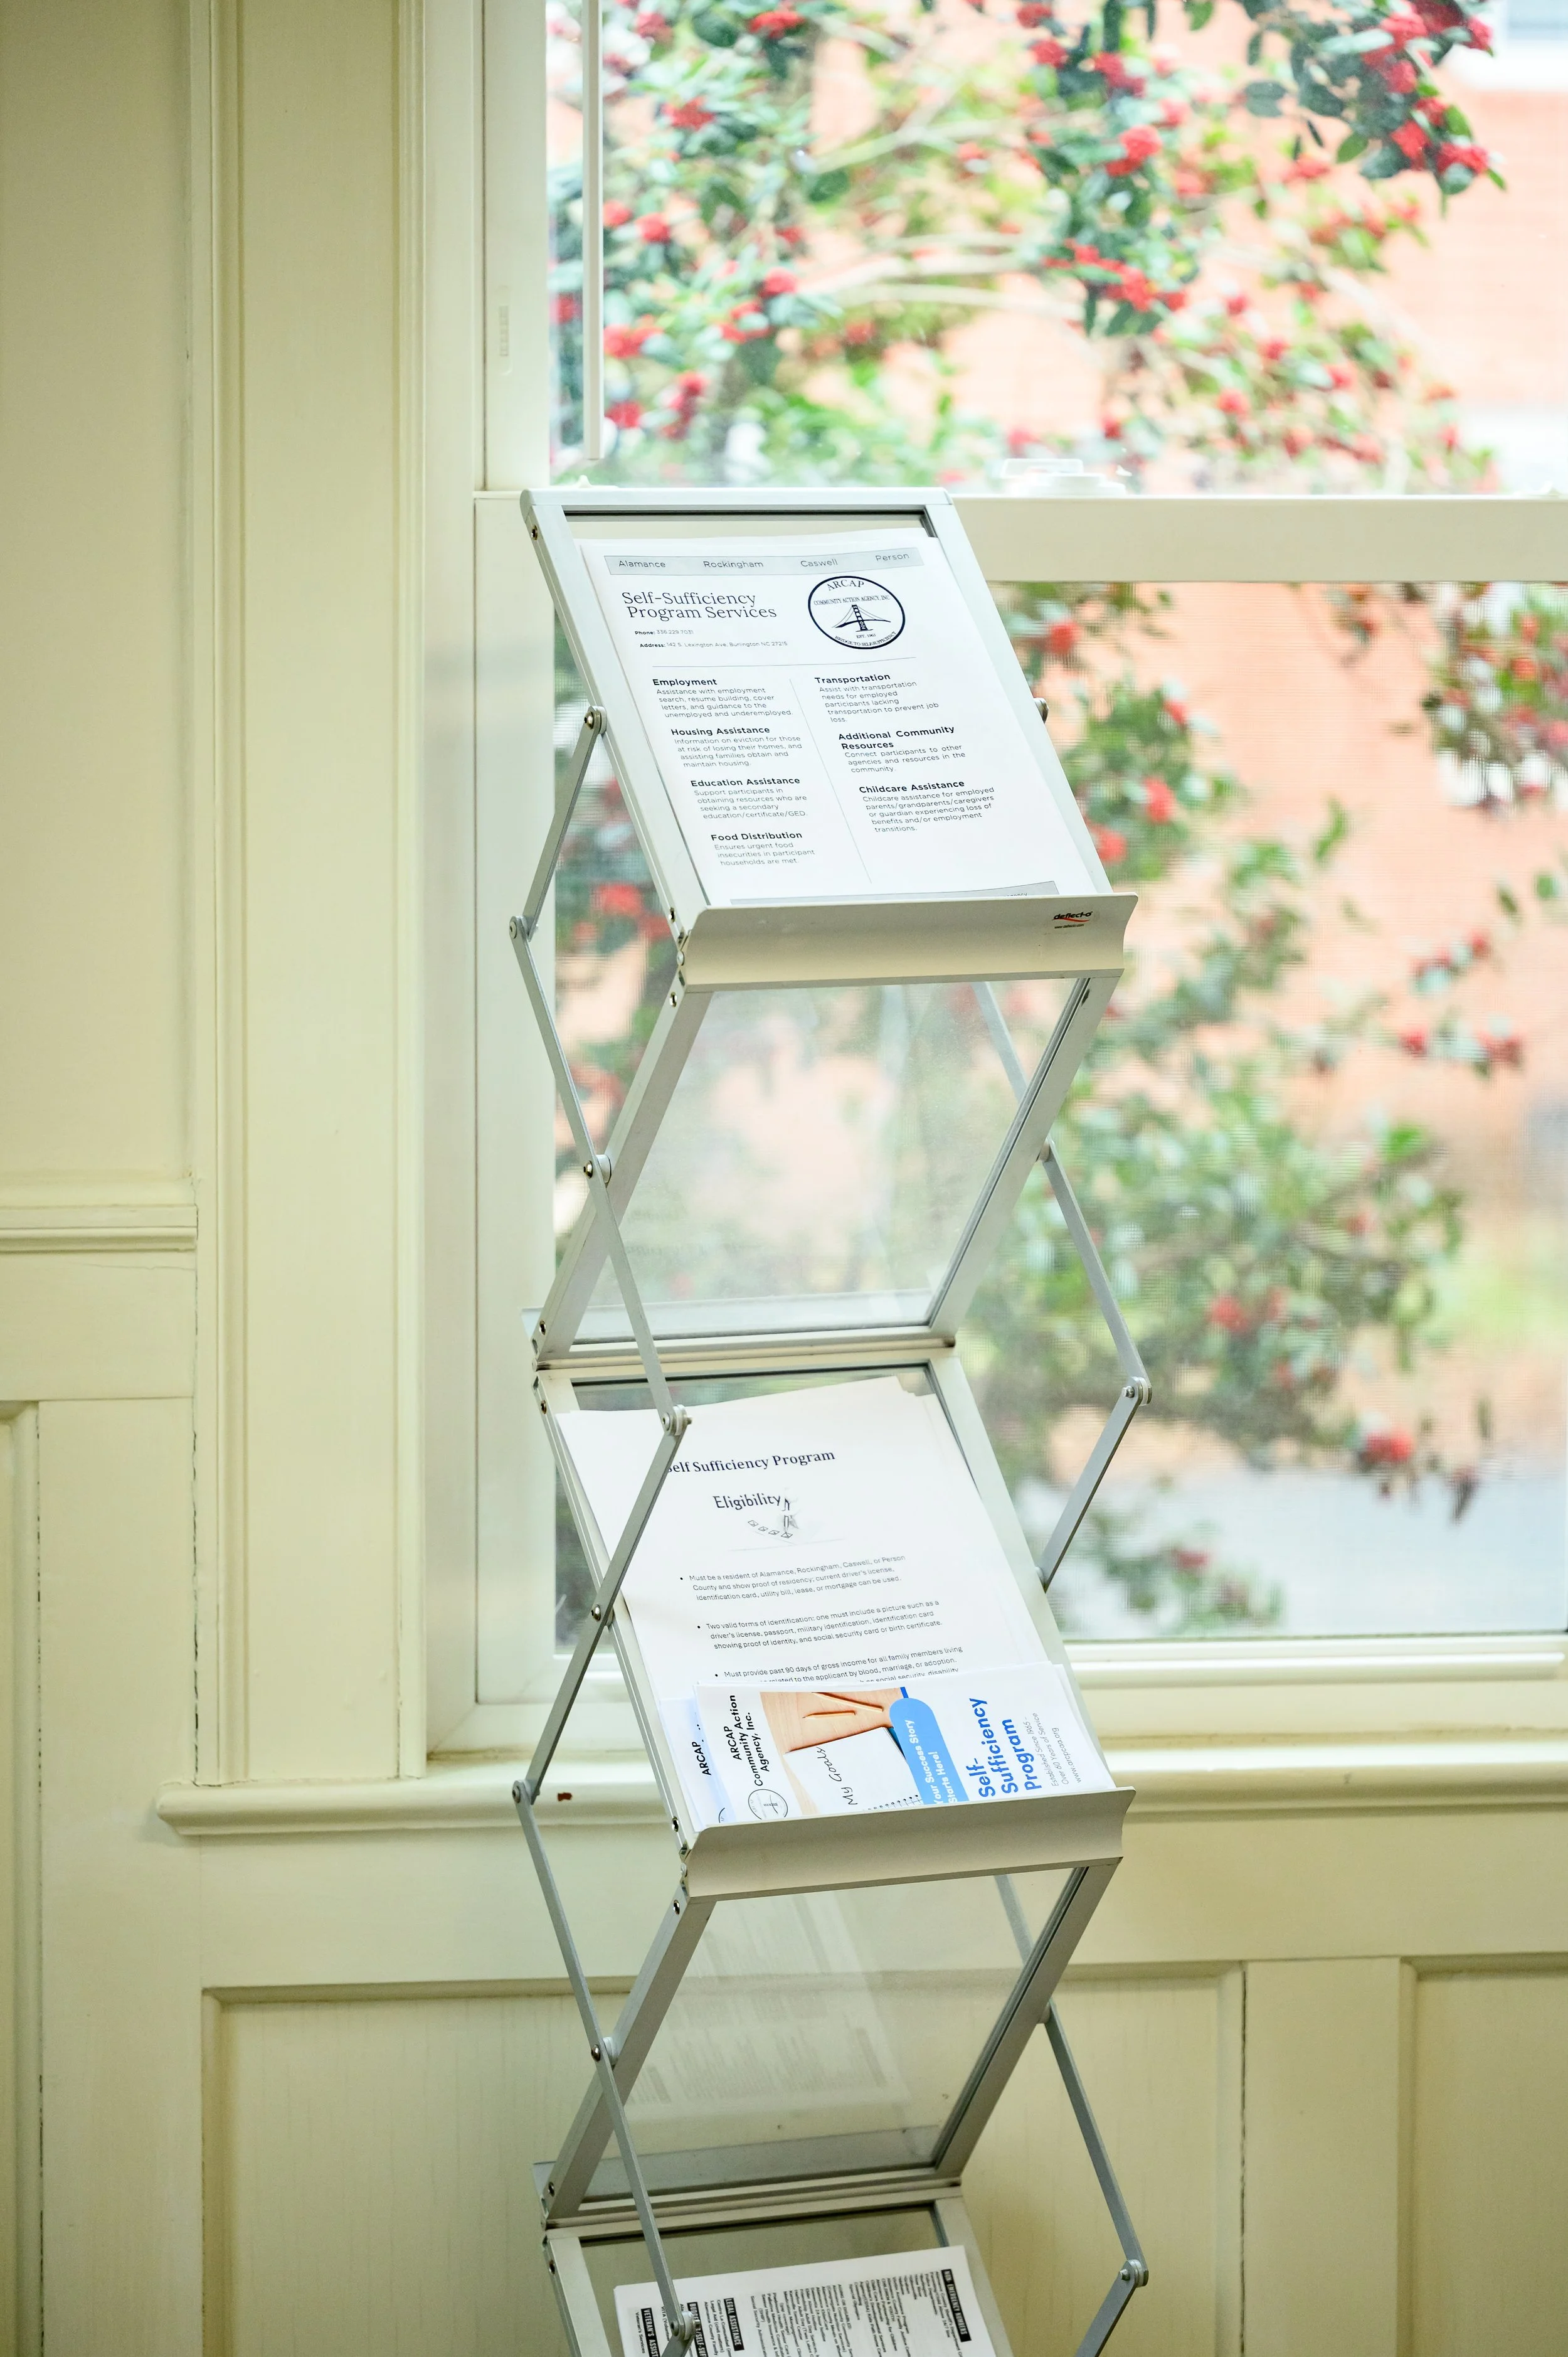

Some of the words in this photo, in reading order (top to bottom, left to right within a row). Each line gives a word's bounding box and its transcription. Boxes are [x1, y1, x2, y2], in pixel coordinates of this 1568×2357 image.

[800, 558, 838, 567] Caswell
[827, 579, 864, 591] ARCAP
[622, 592, 756, 607] Self-Sufficiency
[627, 606, 702, 622] Program
[705, 606, 777, 618] Services
[814, 674, 891, 684] Transportation
[861, 682, 917, 691] transportation
[894, 704, 924, 712] prevent
[839, 732, 891, 740] Additional
[896, 726, 954, 737] Community
[911, 782, 965, 790] Assistance
[955, 787, 995, 796] employed
[866, 796, 994, 810] parents/grandparents/caregivers
[915, 807, 965, 815] experiencing
[933, 812, 982, 821] employment
[741, 832, 802, 840] Distribution
[692, 1459, 768, 1472] Sufficiency
[772, 1452, 835, 1466] Program
[712, 1493, 780, 1510] Eligibility
[797, 1564, 842, 1573] Rockingham,
[843, 1560, 872, 1568] Caswell,
[728, 1695, 743, 1729] Action
[744, 1711, 756, 1730] Inc.
[904, 1719, 919, 1744] Story
[1023, 1721, 1036, 1735] 1965
[1031, 1713, 1046, 1735] Service
[723, 1725, 742, 1760] ARCAP
[968, 1698, 1019, 1794] Sufficiency
[1030, 1736, 1042, 1753] Since
[1044, 1743, 1057, 1760] Years
[691, 1741, 712, 1776] ARCAP
[734, 1732, 764, 1786] Community
[750, 1733, 770, 1772] Agency,
[1000, 1718, 1042, 1790] Program
[1051, 1727, 1082, 1784] www.arcpcaa.org
[815, 1745, 842, 1782] Goals
[914, 1745, 935, 1784] Success
[929, 1751, 946, 1775] Here!
[1037, 1753, 1059, 1787] Established
[1054, 1762, 1062, 1770] 60
[965, 1757, 996, 1797] Self-
[1057, 1770, 1069, 1784] Over
[842, 1786, 858, 1806] My
[929, 1784, 944, 1804] Your
[941, 1776, 958, 1802] Starts
[725, 2299, 734, 2314] LEGAL
[644, 2309, 655, 2337] VETERAN'S
[729, 2315, 741, 2346] ASSISTANCE
